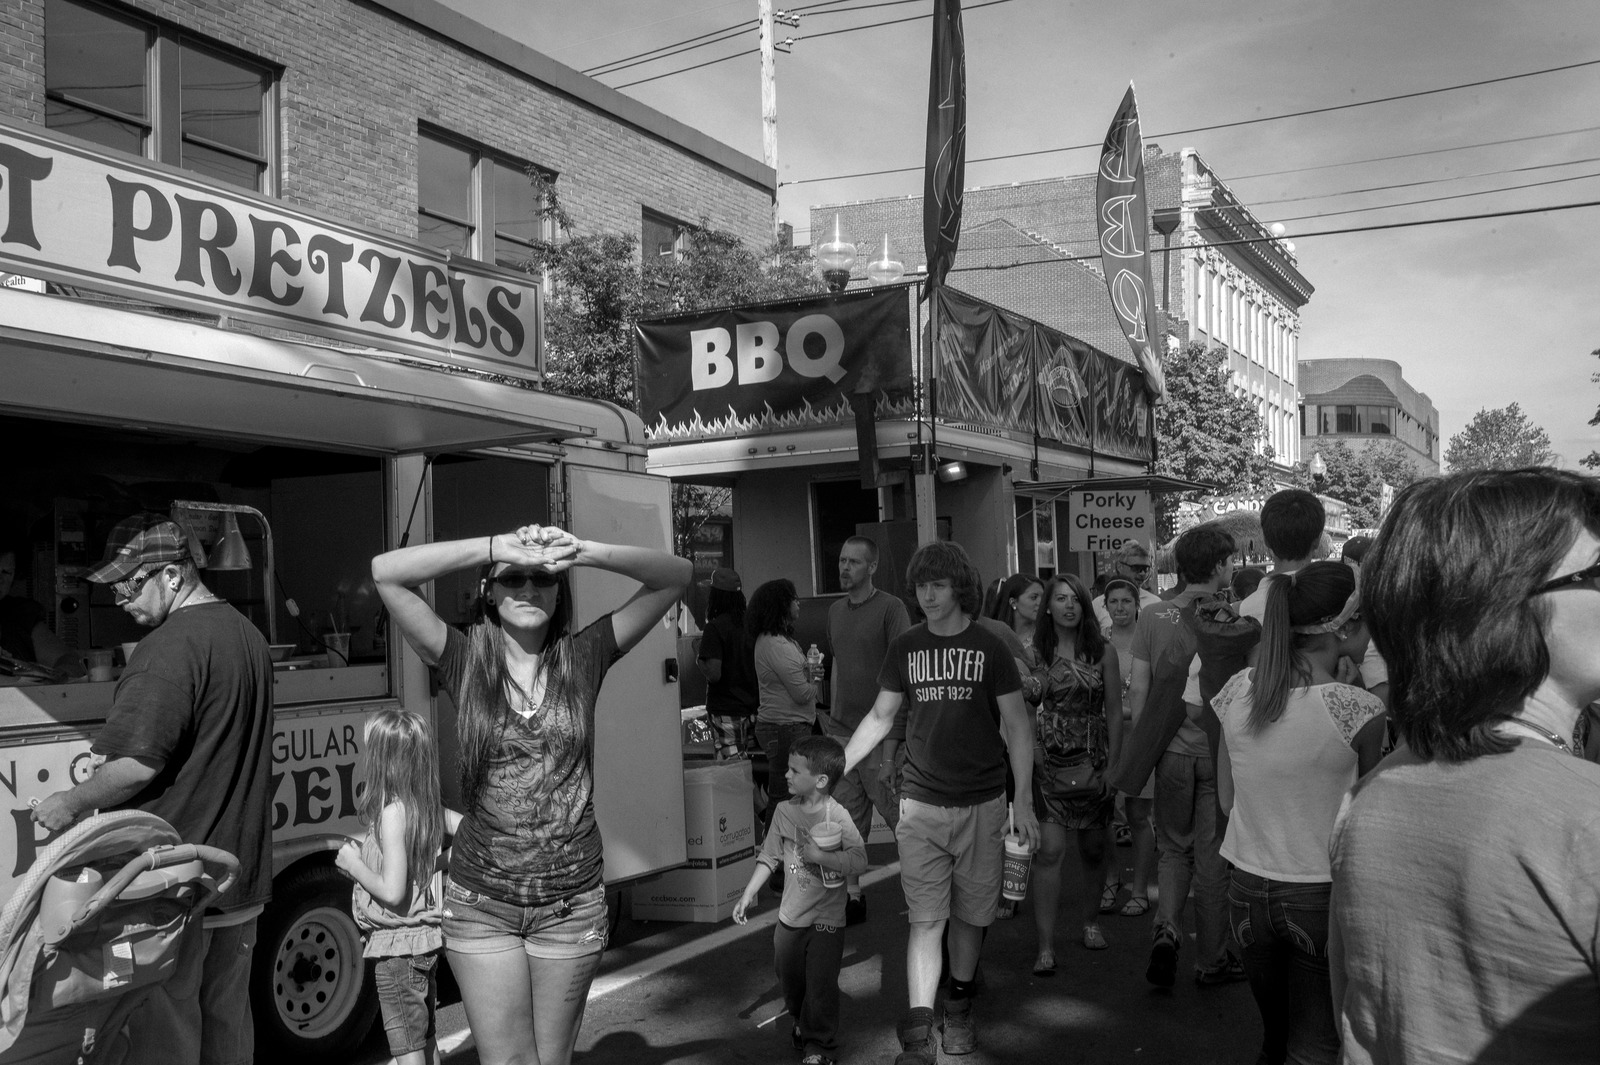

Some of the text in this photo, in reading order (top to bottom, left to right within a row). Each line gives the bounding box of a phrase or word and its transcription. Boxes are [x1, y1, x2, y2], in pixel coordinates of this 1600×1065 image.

[107, 174, 525, 357] PRETZELS
[690, 314, 847, 391] BBQ
[1083, 492, 1136, 511] Porky
[1075, 513, 1145, 529] Cheese
[907, 648, 985, 684] HOLLISTER
[915, 685, 973, 702] SURF 1922
[650, 894, 696, 902] cccbox.com
